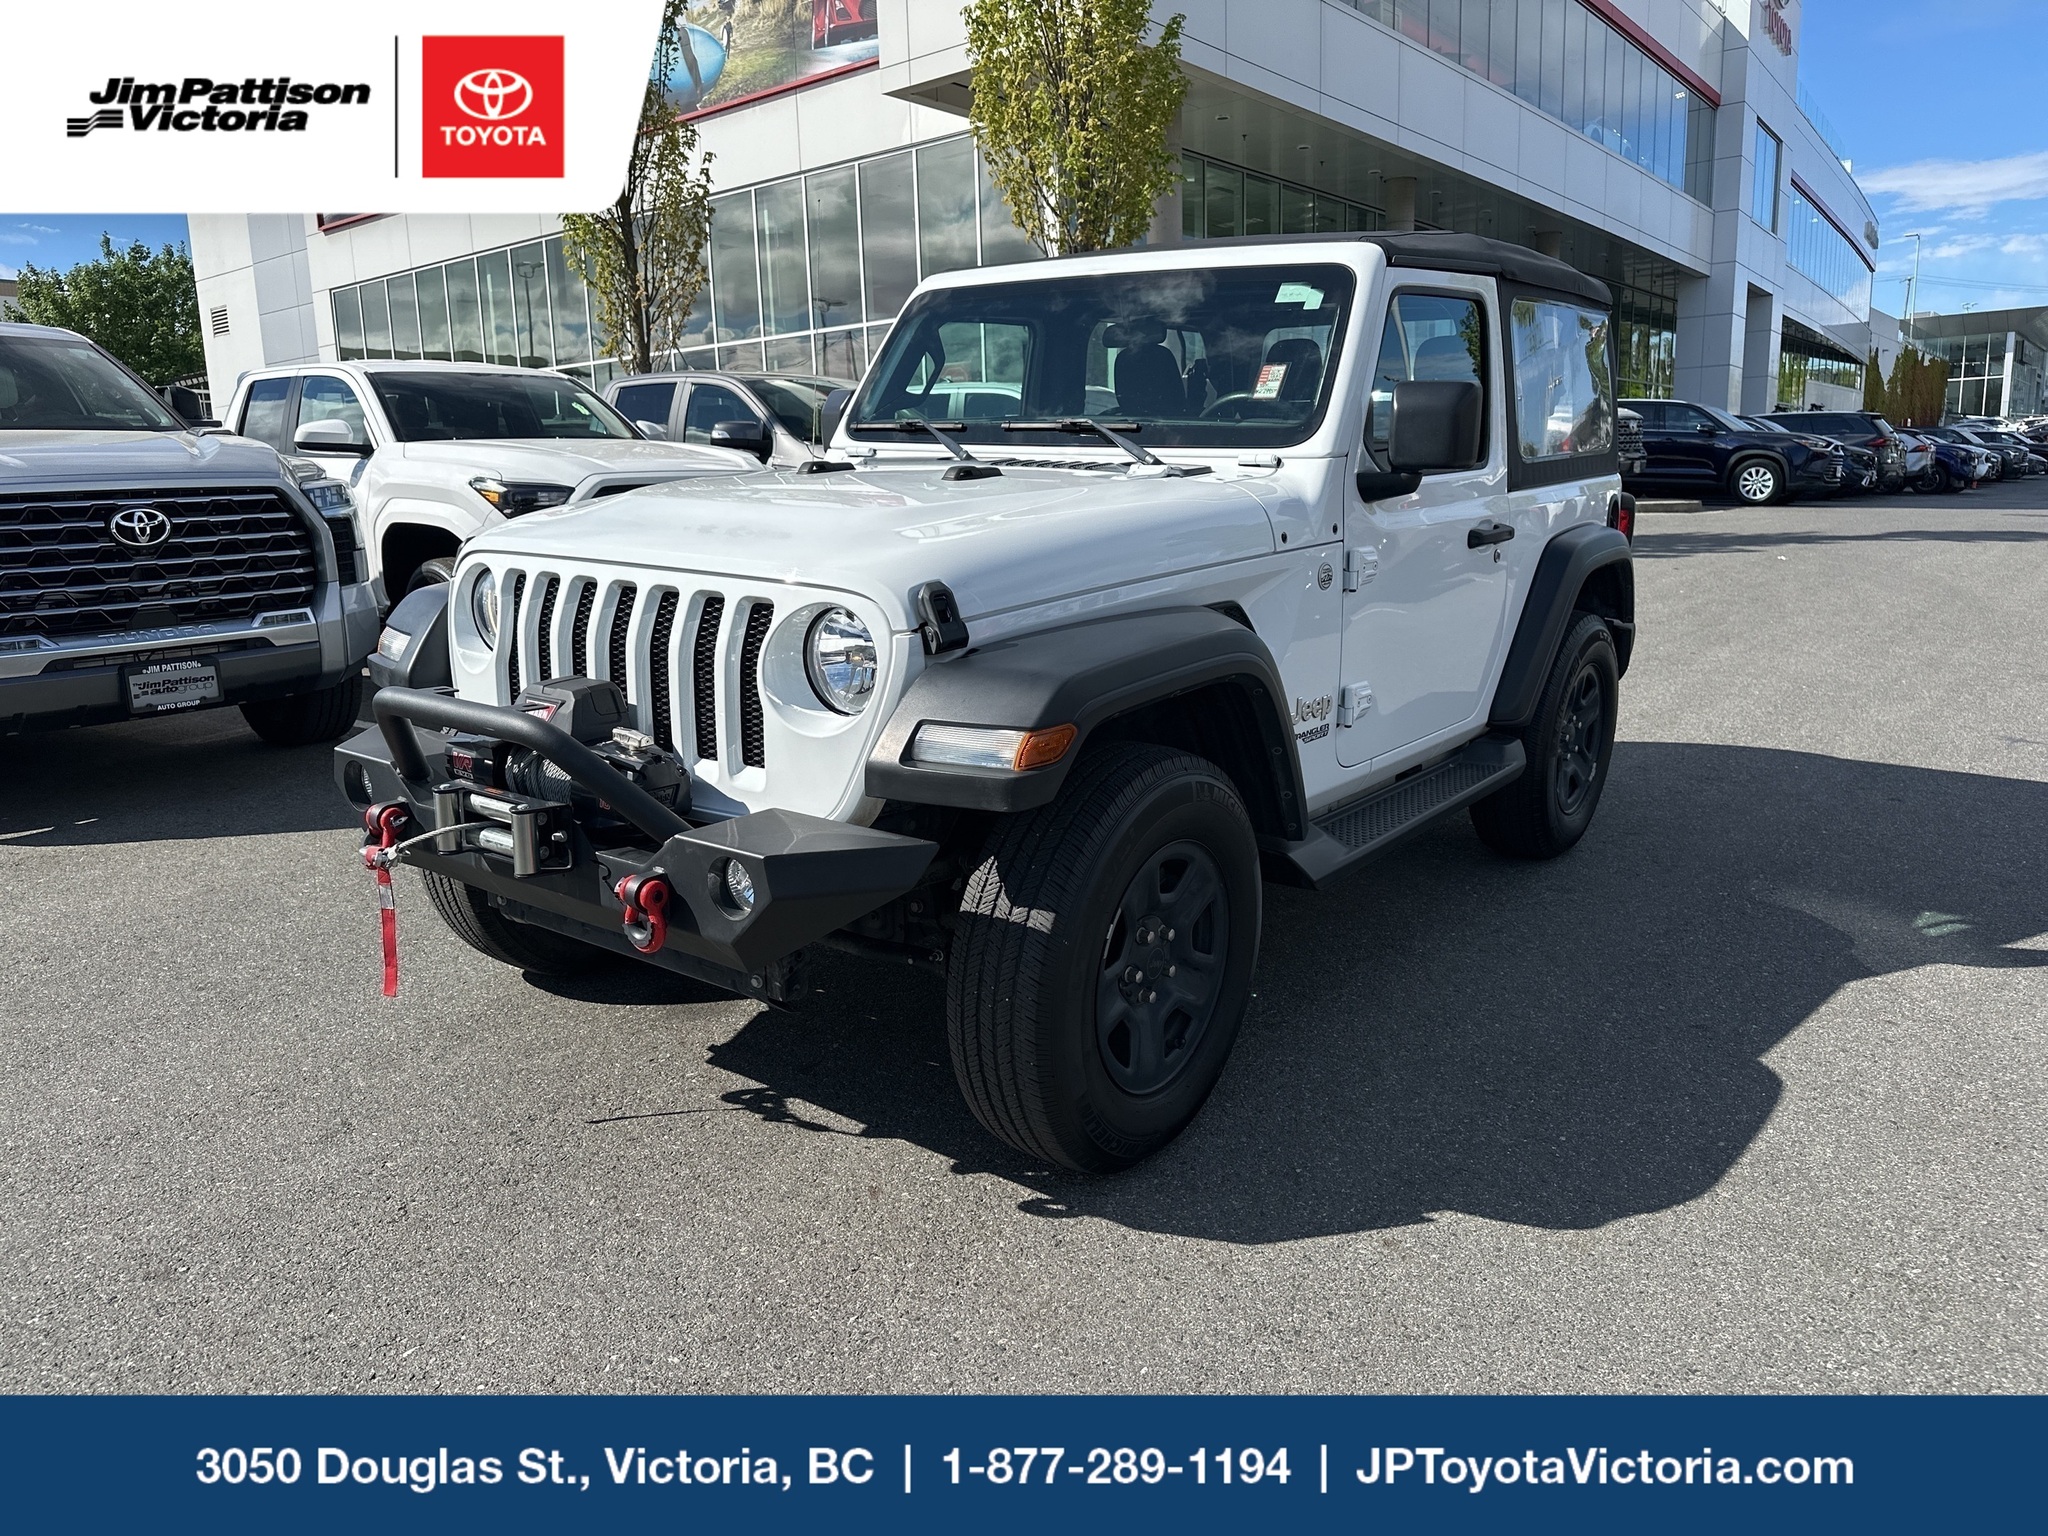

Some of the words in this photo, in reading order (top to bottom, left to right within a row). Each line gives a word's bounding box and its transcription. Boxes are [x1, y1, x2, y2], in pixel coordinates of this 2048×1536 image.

[97, 623, 217, 644] TUNDRA
[146, 664, 161, 675] JIM
[161, 660, 198, 674] PATTISON
[157, 703, 176, 711] AUTO
[177, 700, 201, 709] GROUP
[1290, 694, 1333, 726] Jeep
[1295, 723, 1330, 741] RANGLER
